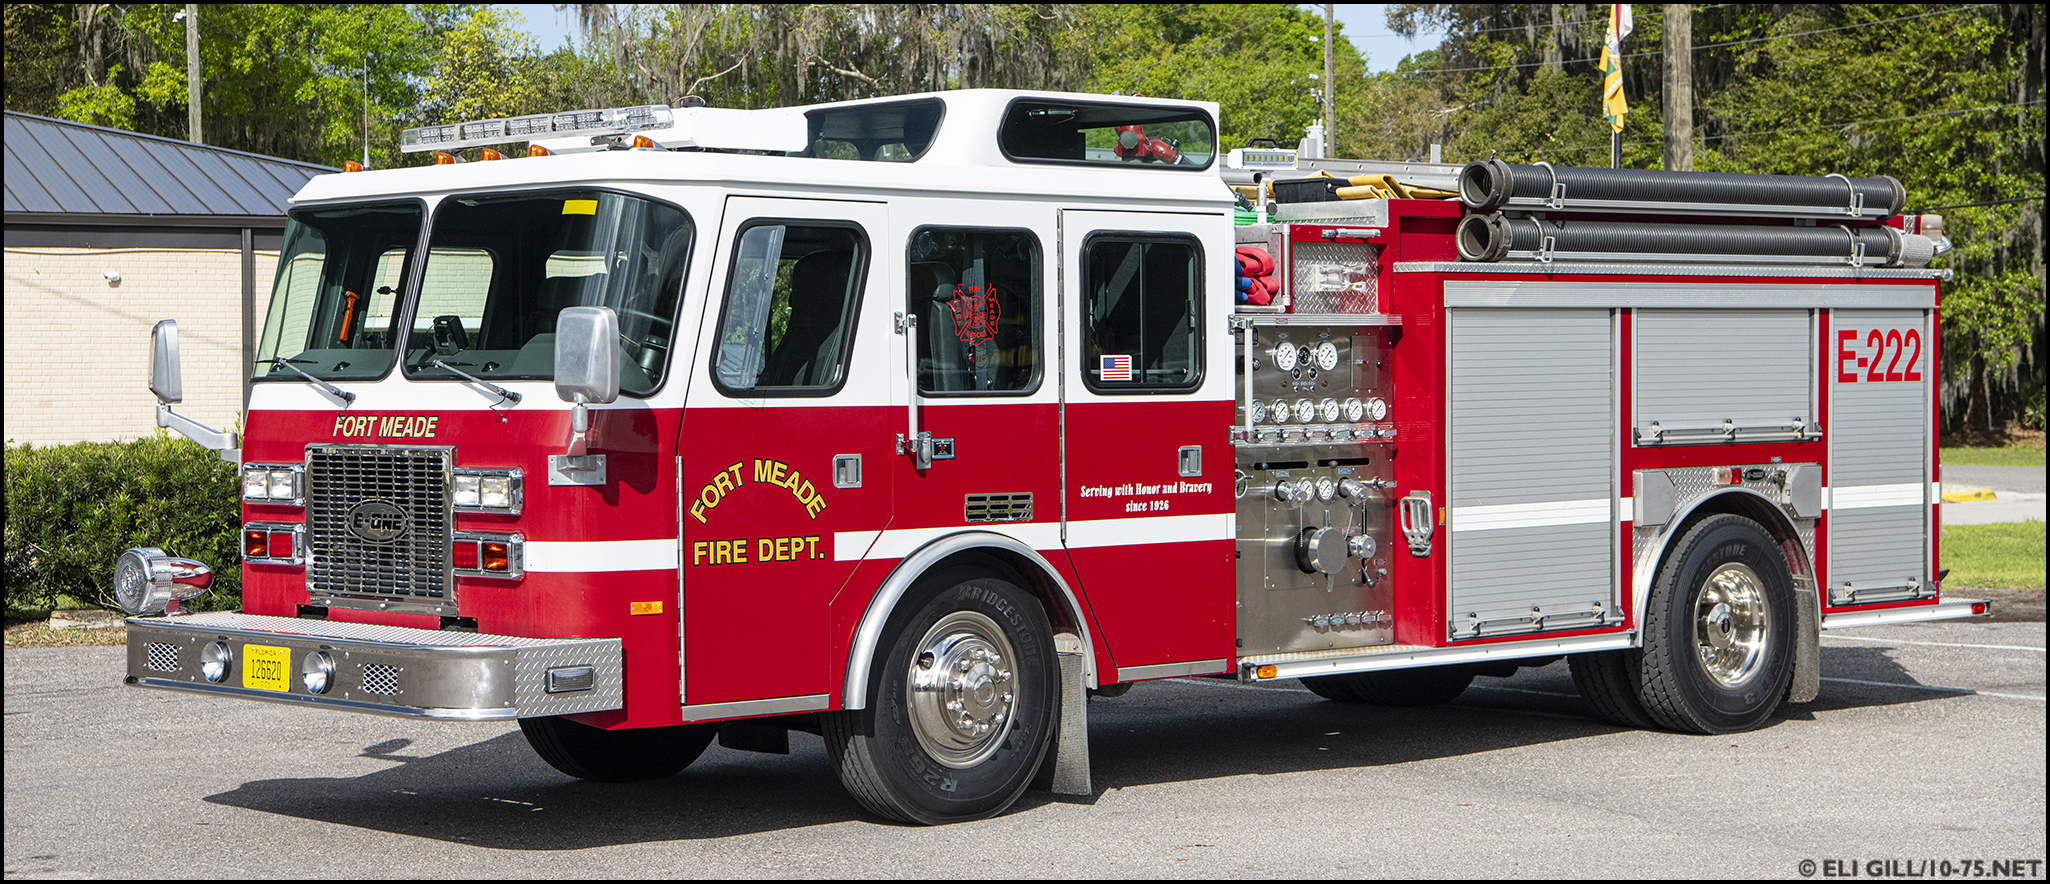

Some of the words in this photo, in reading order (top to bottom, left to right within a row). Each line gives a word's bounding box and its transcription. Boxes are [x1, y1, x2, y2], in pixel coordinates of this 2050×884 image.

[988, 297, 996, 326] MEADE
[966, 330, 988, 339] RESCUE
[1837, 328, 1922, 384] E-222
[332, 415, 379, 438] FORT
[378, 415, 439, 438] MEADE
[688, 461, 744, 525] FORT
[753, 458, 828, 521] MEADE
[1080, 484, 1113, 499] Serving
[1115, 483, 1134, 496] with
[1135, 483, 1161, 496] Honor
[1162, 481, 1178, 494] and
[1179, 481, 1213, 495] Bravery
[1125, 500, 1148, 513] since
[1149, 499, 1170, 511] 1926
[353, 510, 403, 532] E-ONE
[693, 539, 748, 566] FIRE
[758, 535, 825, 562] DEPT.
[957, 585, 1039, 667] BRIDGESTONE
[251, 659, 282, 681] 126620
